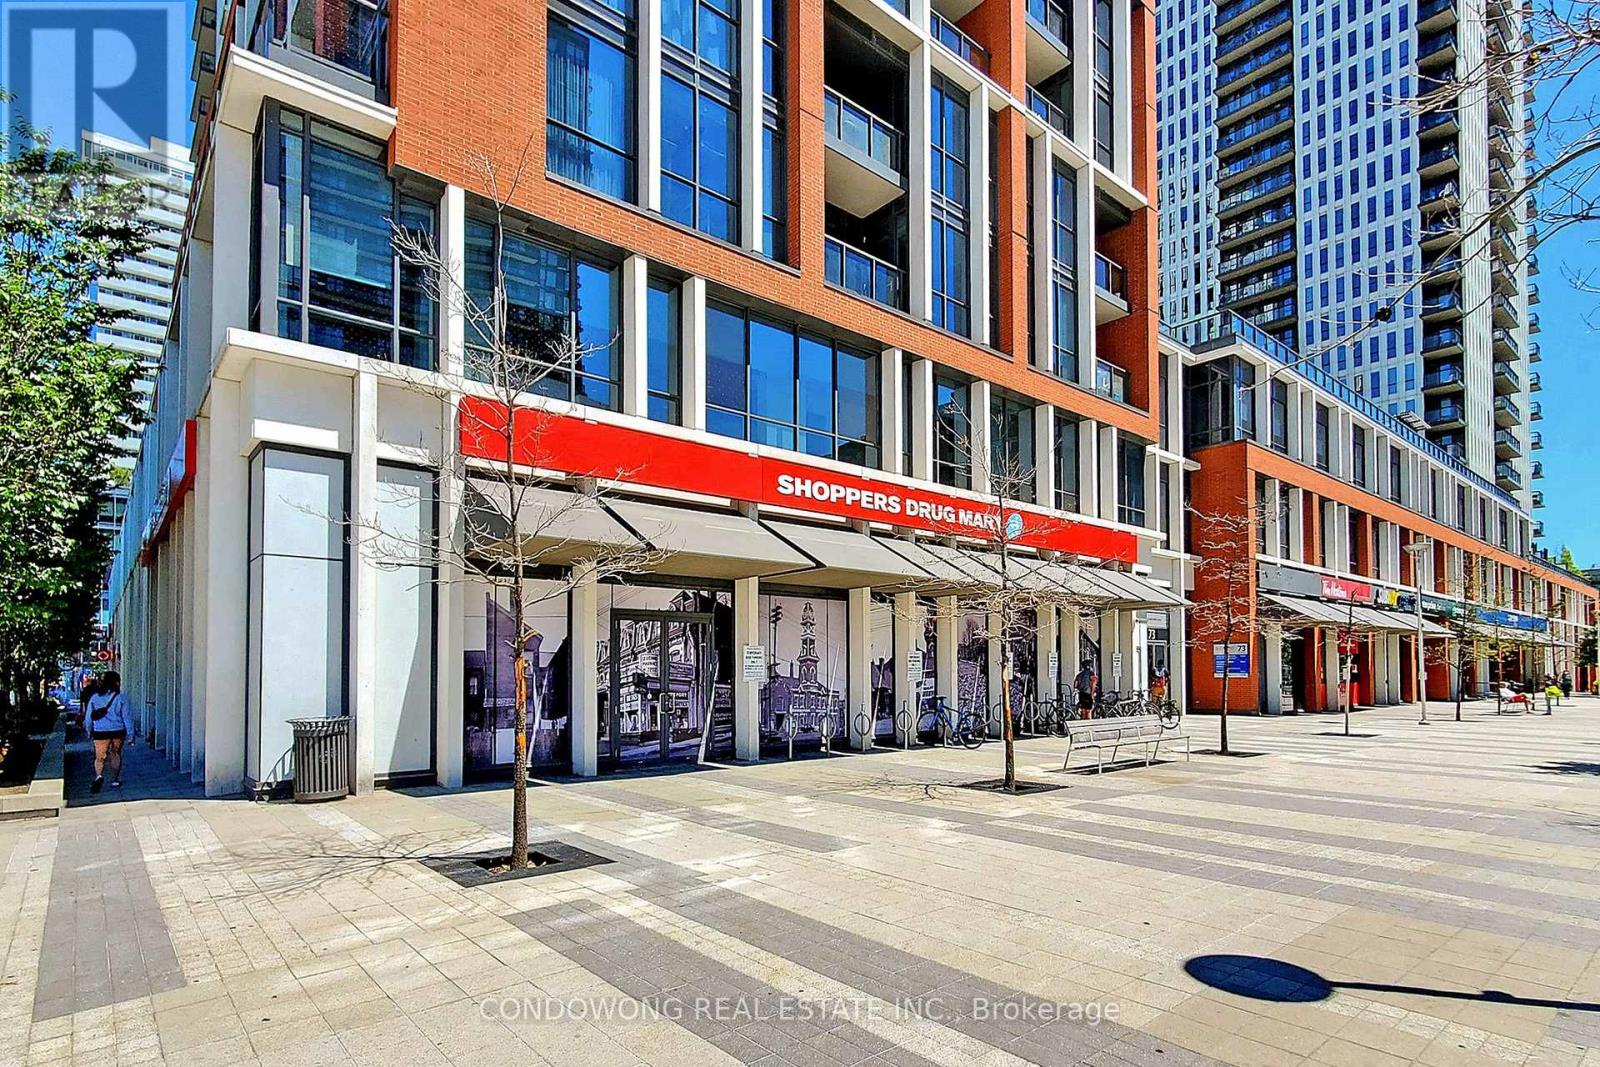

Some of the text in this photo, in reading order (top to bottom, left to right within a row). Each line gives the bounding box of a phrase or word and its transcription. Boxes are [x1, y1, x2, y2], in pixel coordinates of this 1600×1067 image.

[776, 474, 901, 514] SHOPPERS
[905, 498, 956, 523] DRUG
[1148, 629, 1156, 640] 73
